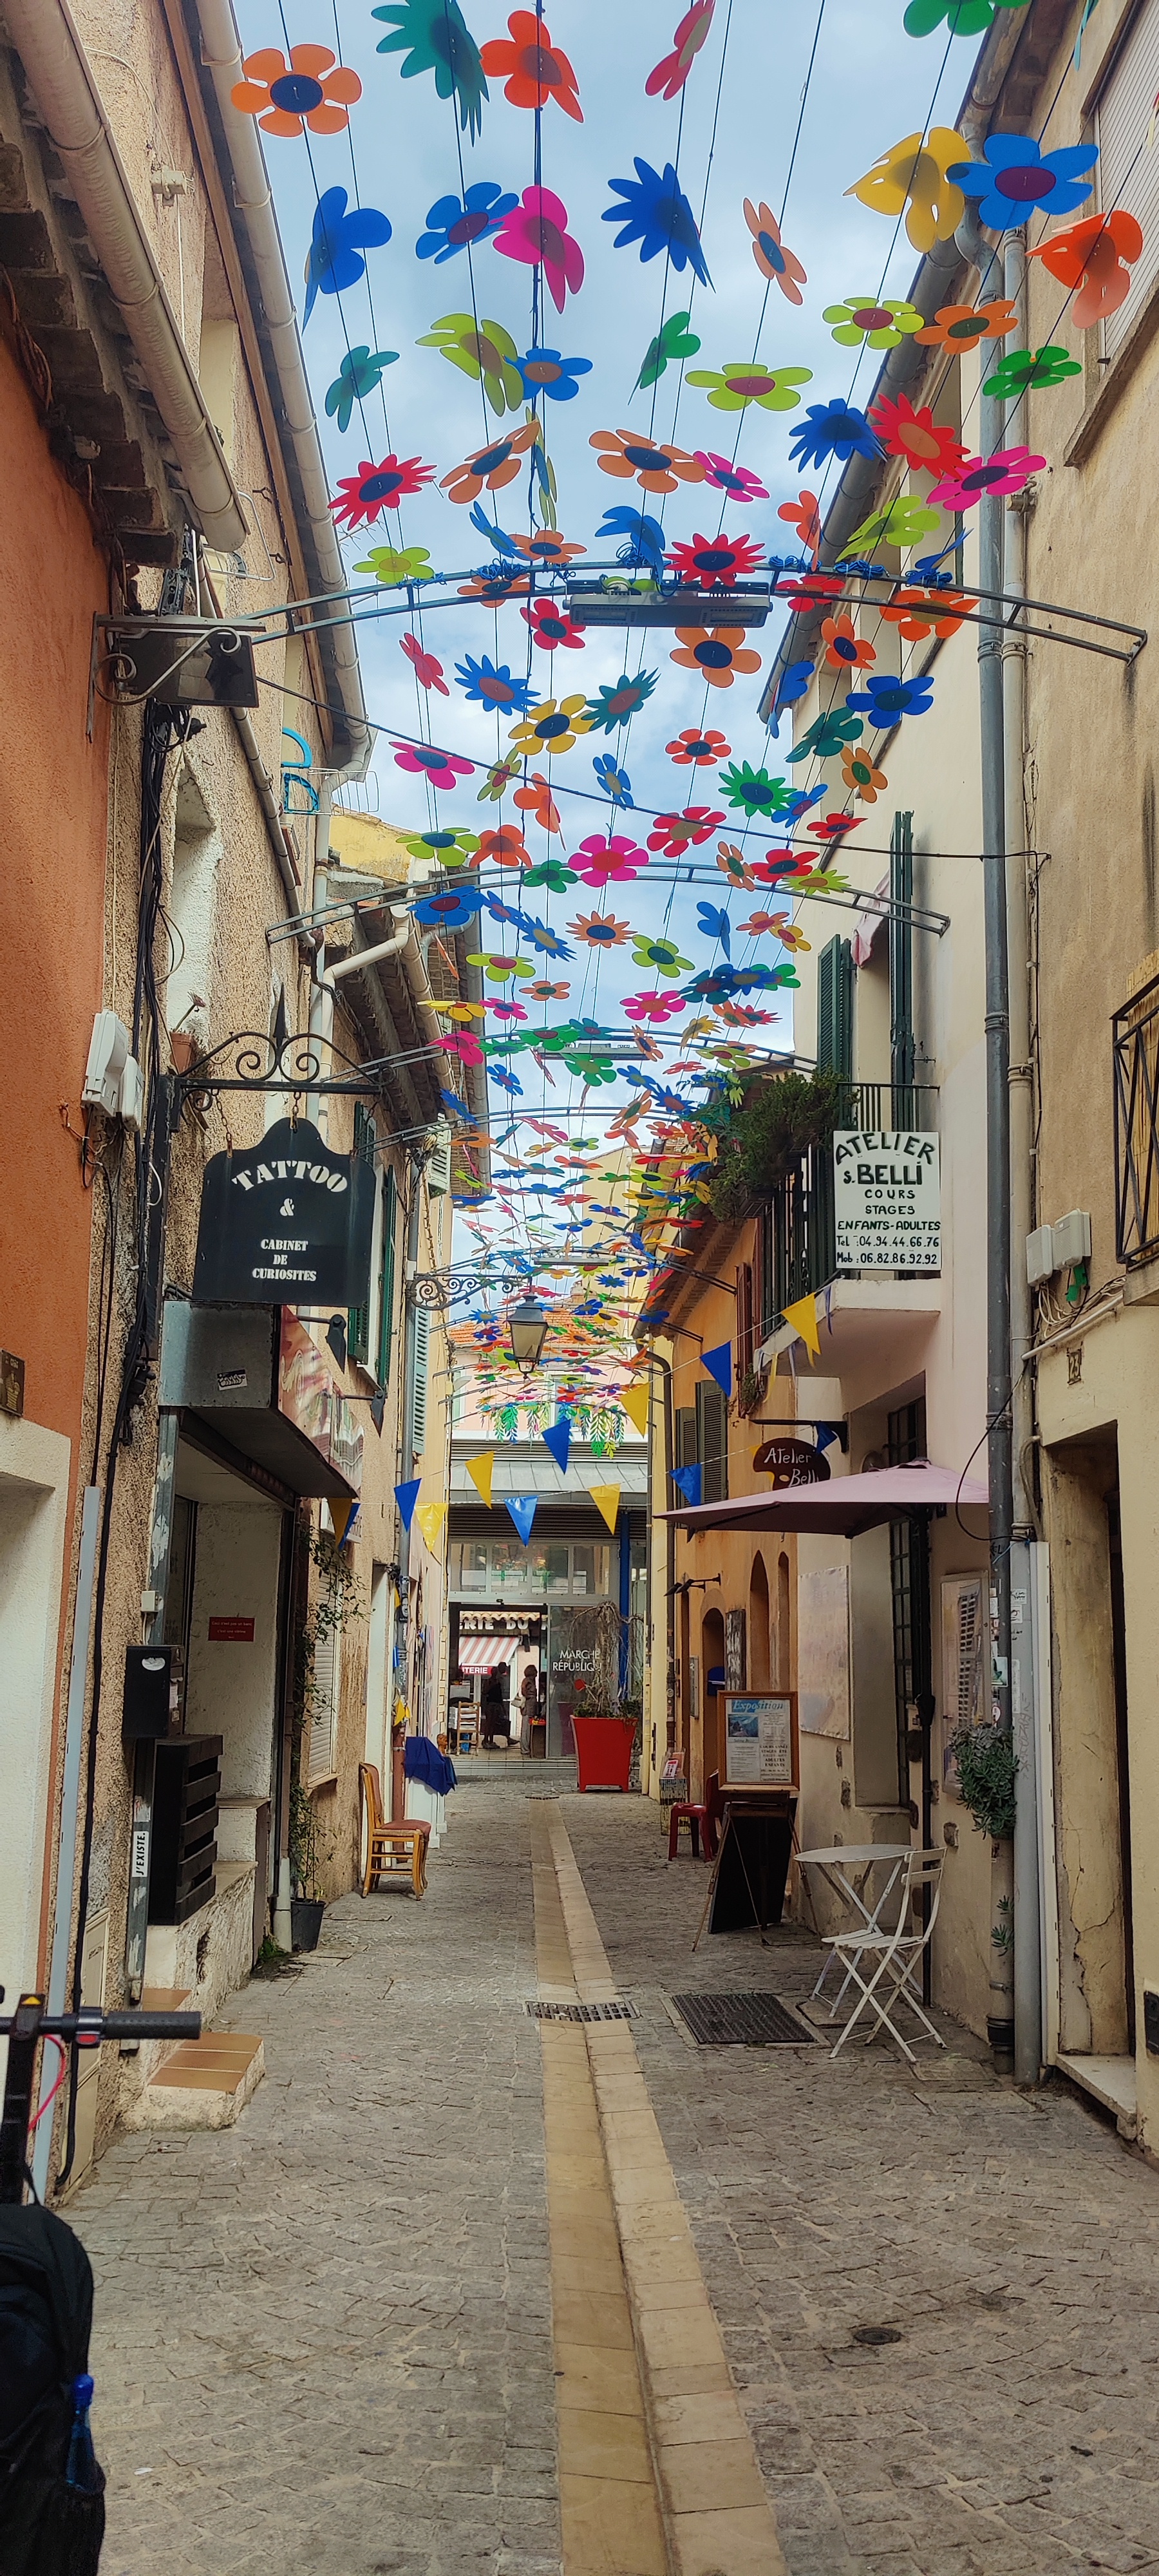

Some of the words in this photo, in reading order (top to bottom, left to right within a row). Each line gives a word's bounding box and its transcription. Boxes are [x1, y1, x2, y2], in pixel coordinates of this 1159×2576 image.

[835, 1132, 936, 1166] ATELIER
[231, 1160, 348, 1192] TATTOO
[864, 1189, 916, 1199] COURS
[279, 1198, 295, 1216] &
[865, 1205, 916, 1215] STAGES
[260, 1238, 308, 1251] CABINET
[272, 1254, 288, 1265] DE
[837, 1252, 853, 1263] Mob
[252, 1267, 317, 1282] CURIOSITES
[1069, 1354, 1079, 1378] 23
[506, 1619, 529, 1630] DU
[733, 1700, 784, 1712] Exposition
[136, 1833, 146, 1875] J'EXISTE.
